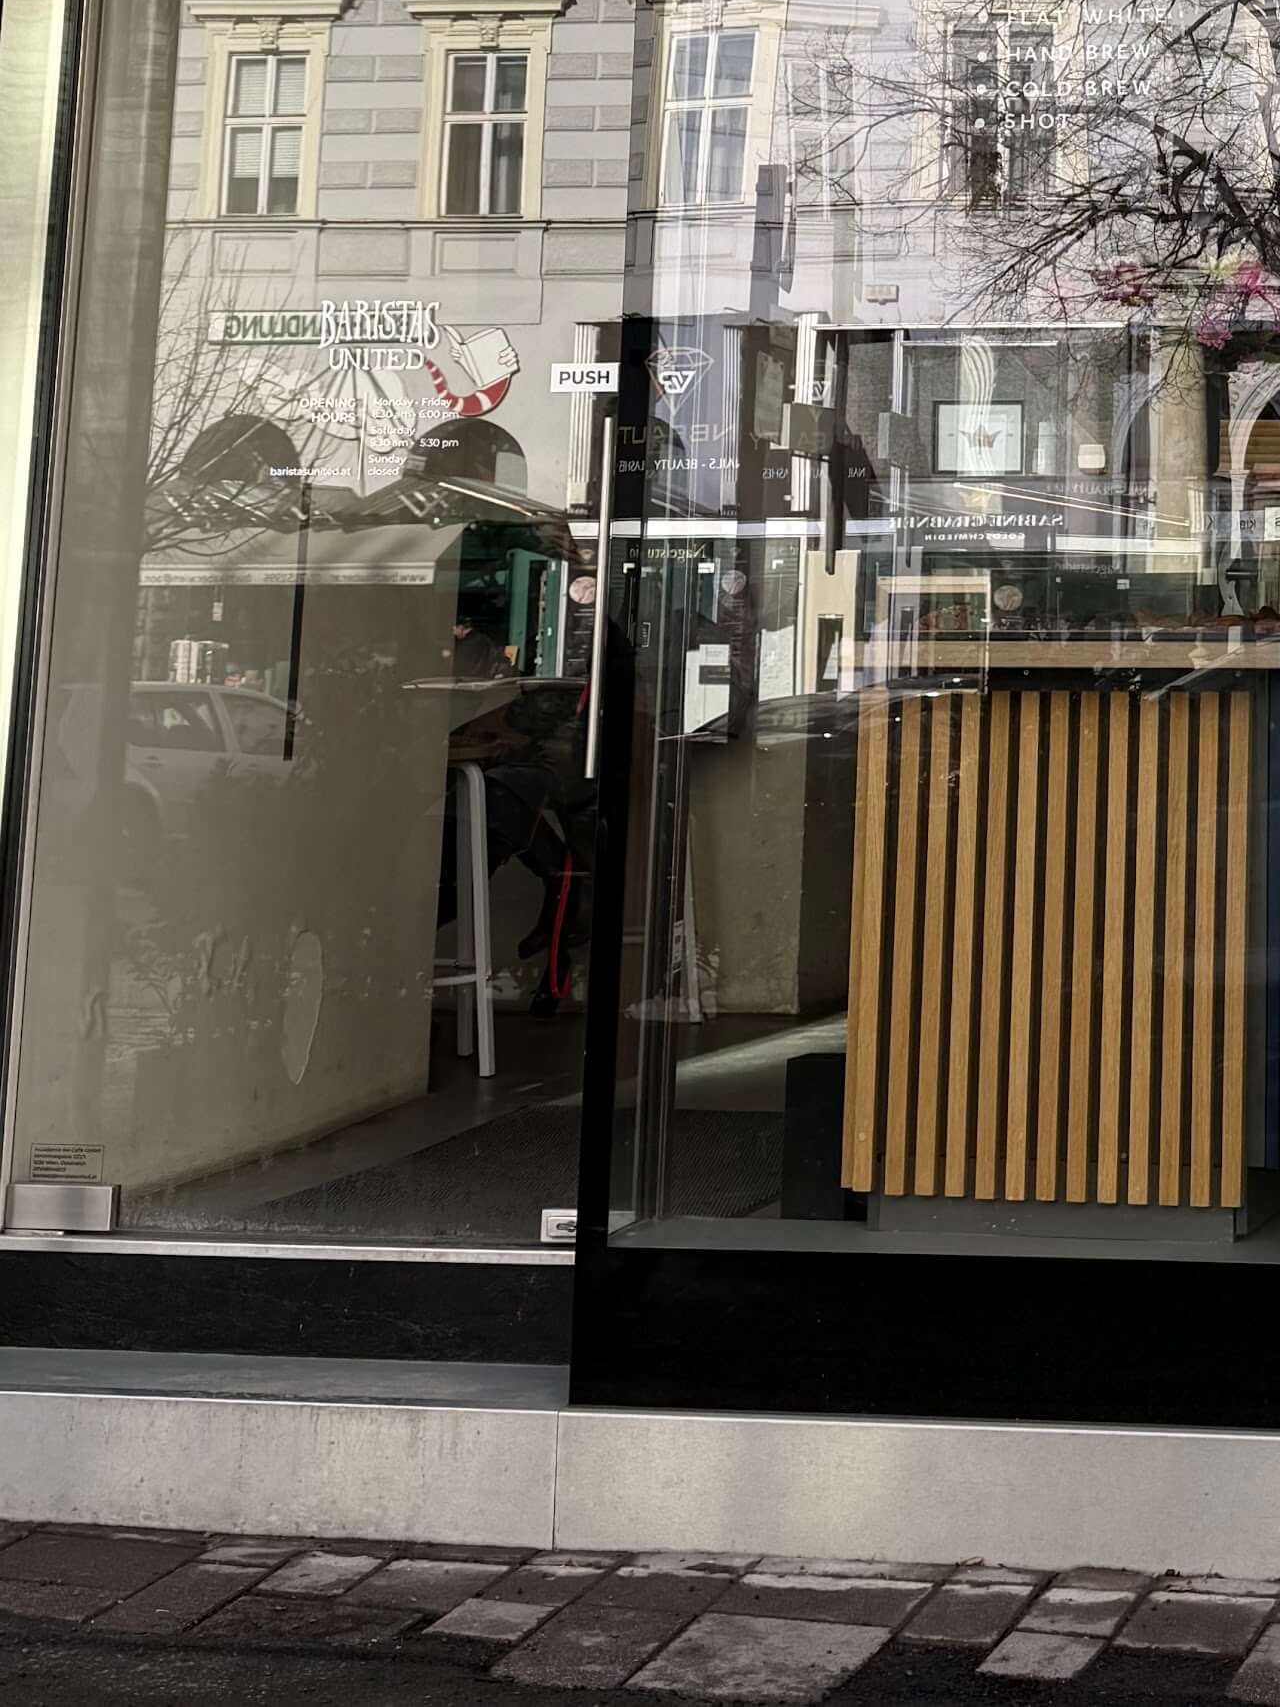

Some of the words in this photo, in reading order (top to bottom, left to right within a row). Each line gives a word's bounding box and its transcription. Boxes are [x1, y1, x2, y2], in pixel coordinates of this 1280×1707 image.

[1006, 9, 1066, 25] FLAT
[1085, 8, 1167, 24] WHITE
[1006, 46, 1072, 62] HAND
[1086, 44, 1151, 60] BREW
[1005, 81, 1072, 96] COLD
[1085, 80, 1152, 95] BREW
[1003, 113, 1071, 129] SHOT
[319, 300, 440, 350] BARISTAS
[328, 348, 425, 371] UNITED
[559, 370, 610, 385] PUSH
[300, 398, 356, 408] OPENING
[373, 398, 413, 408] Monday
[421, 397, 452, 409] Friday
[311, 412, 356, 423] HOURS
[369, 426, 415, 437] Saturday
[442, 440, 459, 449] pm
[368, 454, 407, 466] Sunday
[367, 466, 400, 476] closed
